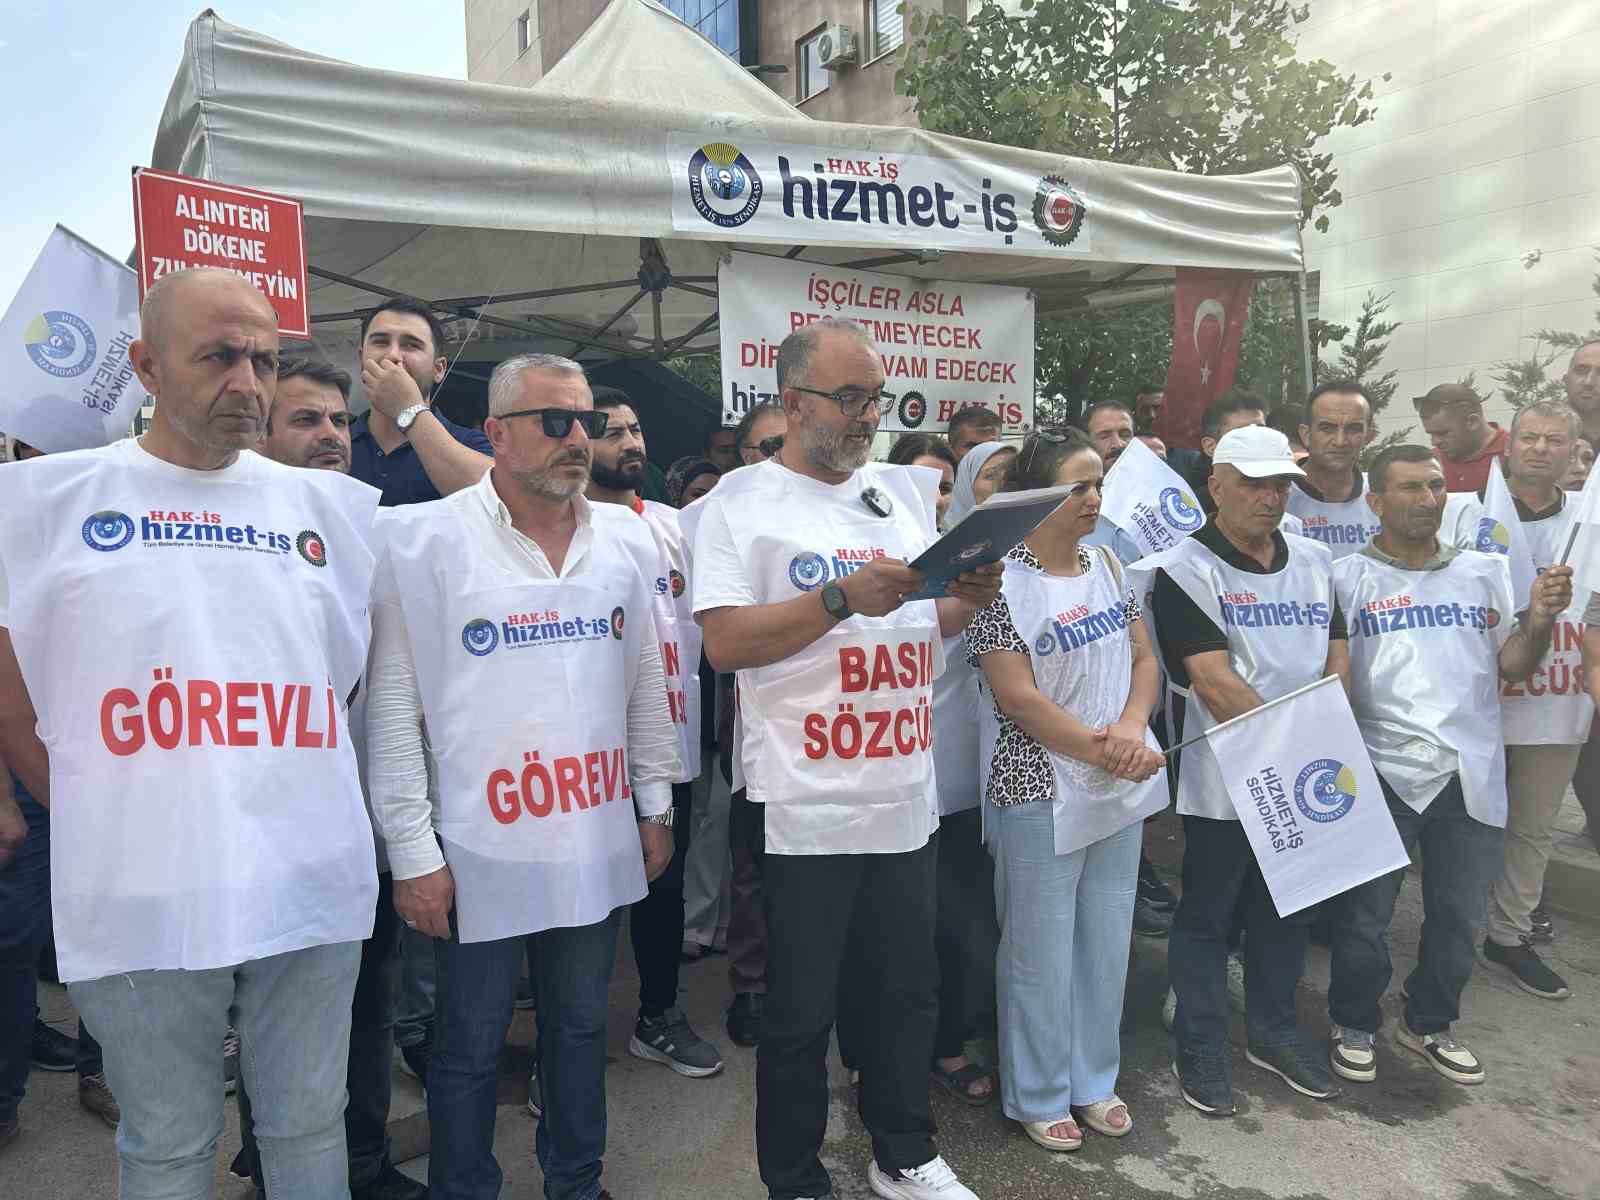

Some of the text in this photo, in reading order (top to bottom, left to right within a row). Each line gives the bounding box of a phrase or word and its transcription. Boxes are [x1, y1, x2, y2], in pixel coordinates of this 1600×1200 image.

[827, 156, 899, 182] HAK-İŞ
[175, 194, 271, 233] ALINTERİ
[778, 156, 1018, 245] hizmet-iş
[183, 225, 267, 264] DÖKENE
[808, 272, 965, 317] İŞÇİLER ASLA
[935, 358, 1017, 384] EDECEK
[141, 516, 292, 555] hizmet-iş
[1134, 502, 1176, 548] HİZMET-
[502, 616, 610, 644] hizmet-iş
[1359, 602, 1488, 636] hizmet-iş
[99, 667, 338, 757] GÖREVLİ
[803, 694, 933, 760] SÖZCÜ
[486, 748, 633, 825] GÖREVL
[1260, 766, 1304, 849] HİZMET-İŞ
[1246, 776, 1287, 853] SENDİKASI
